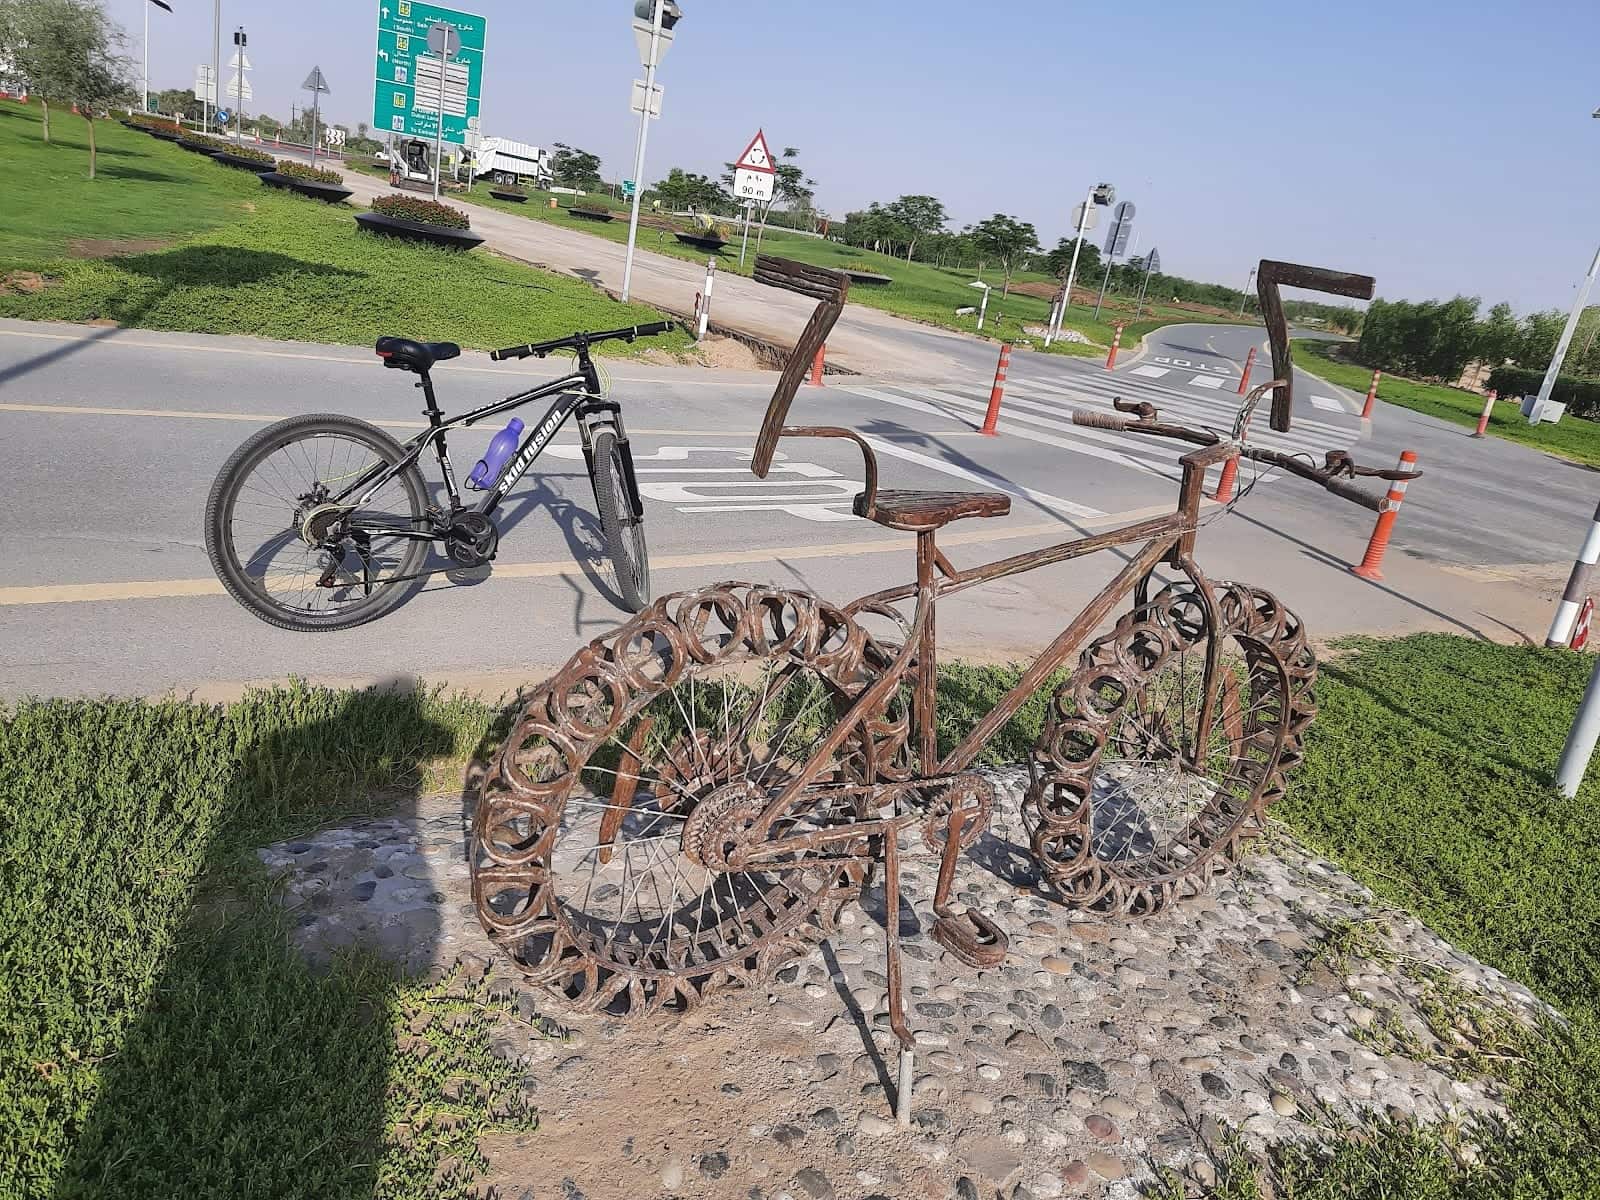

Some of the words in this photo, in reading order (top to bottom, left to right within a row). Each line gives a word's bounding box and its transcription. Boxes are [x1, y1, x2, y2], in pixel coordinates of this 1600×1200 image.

[742, 185, 754, 195] 90
[756, 189, 764, 197] m
[1155, 356, 1231, 374] STOP
[523, 409, 562, 461] fusion
